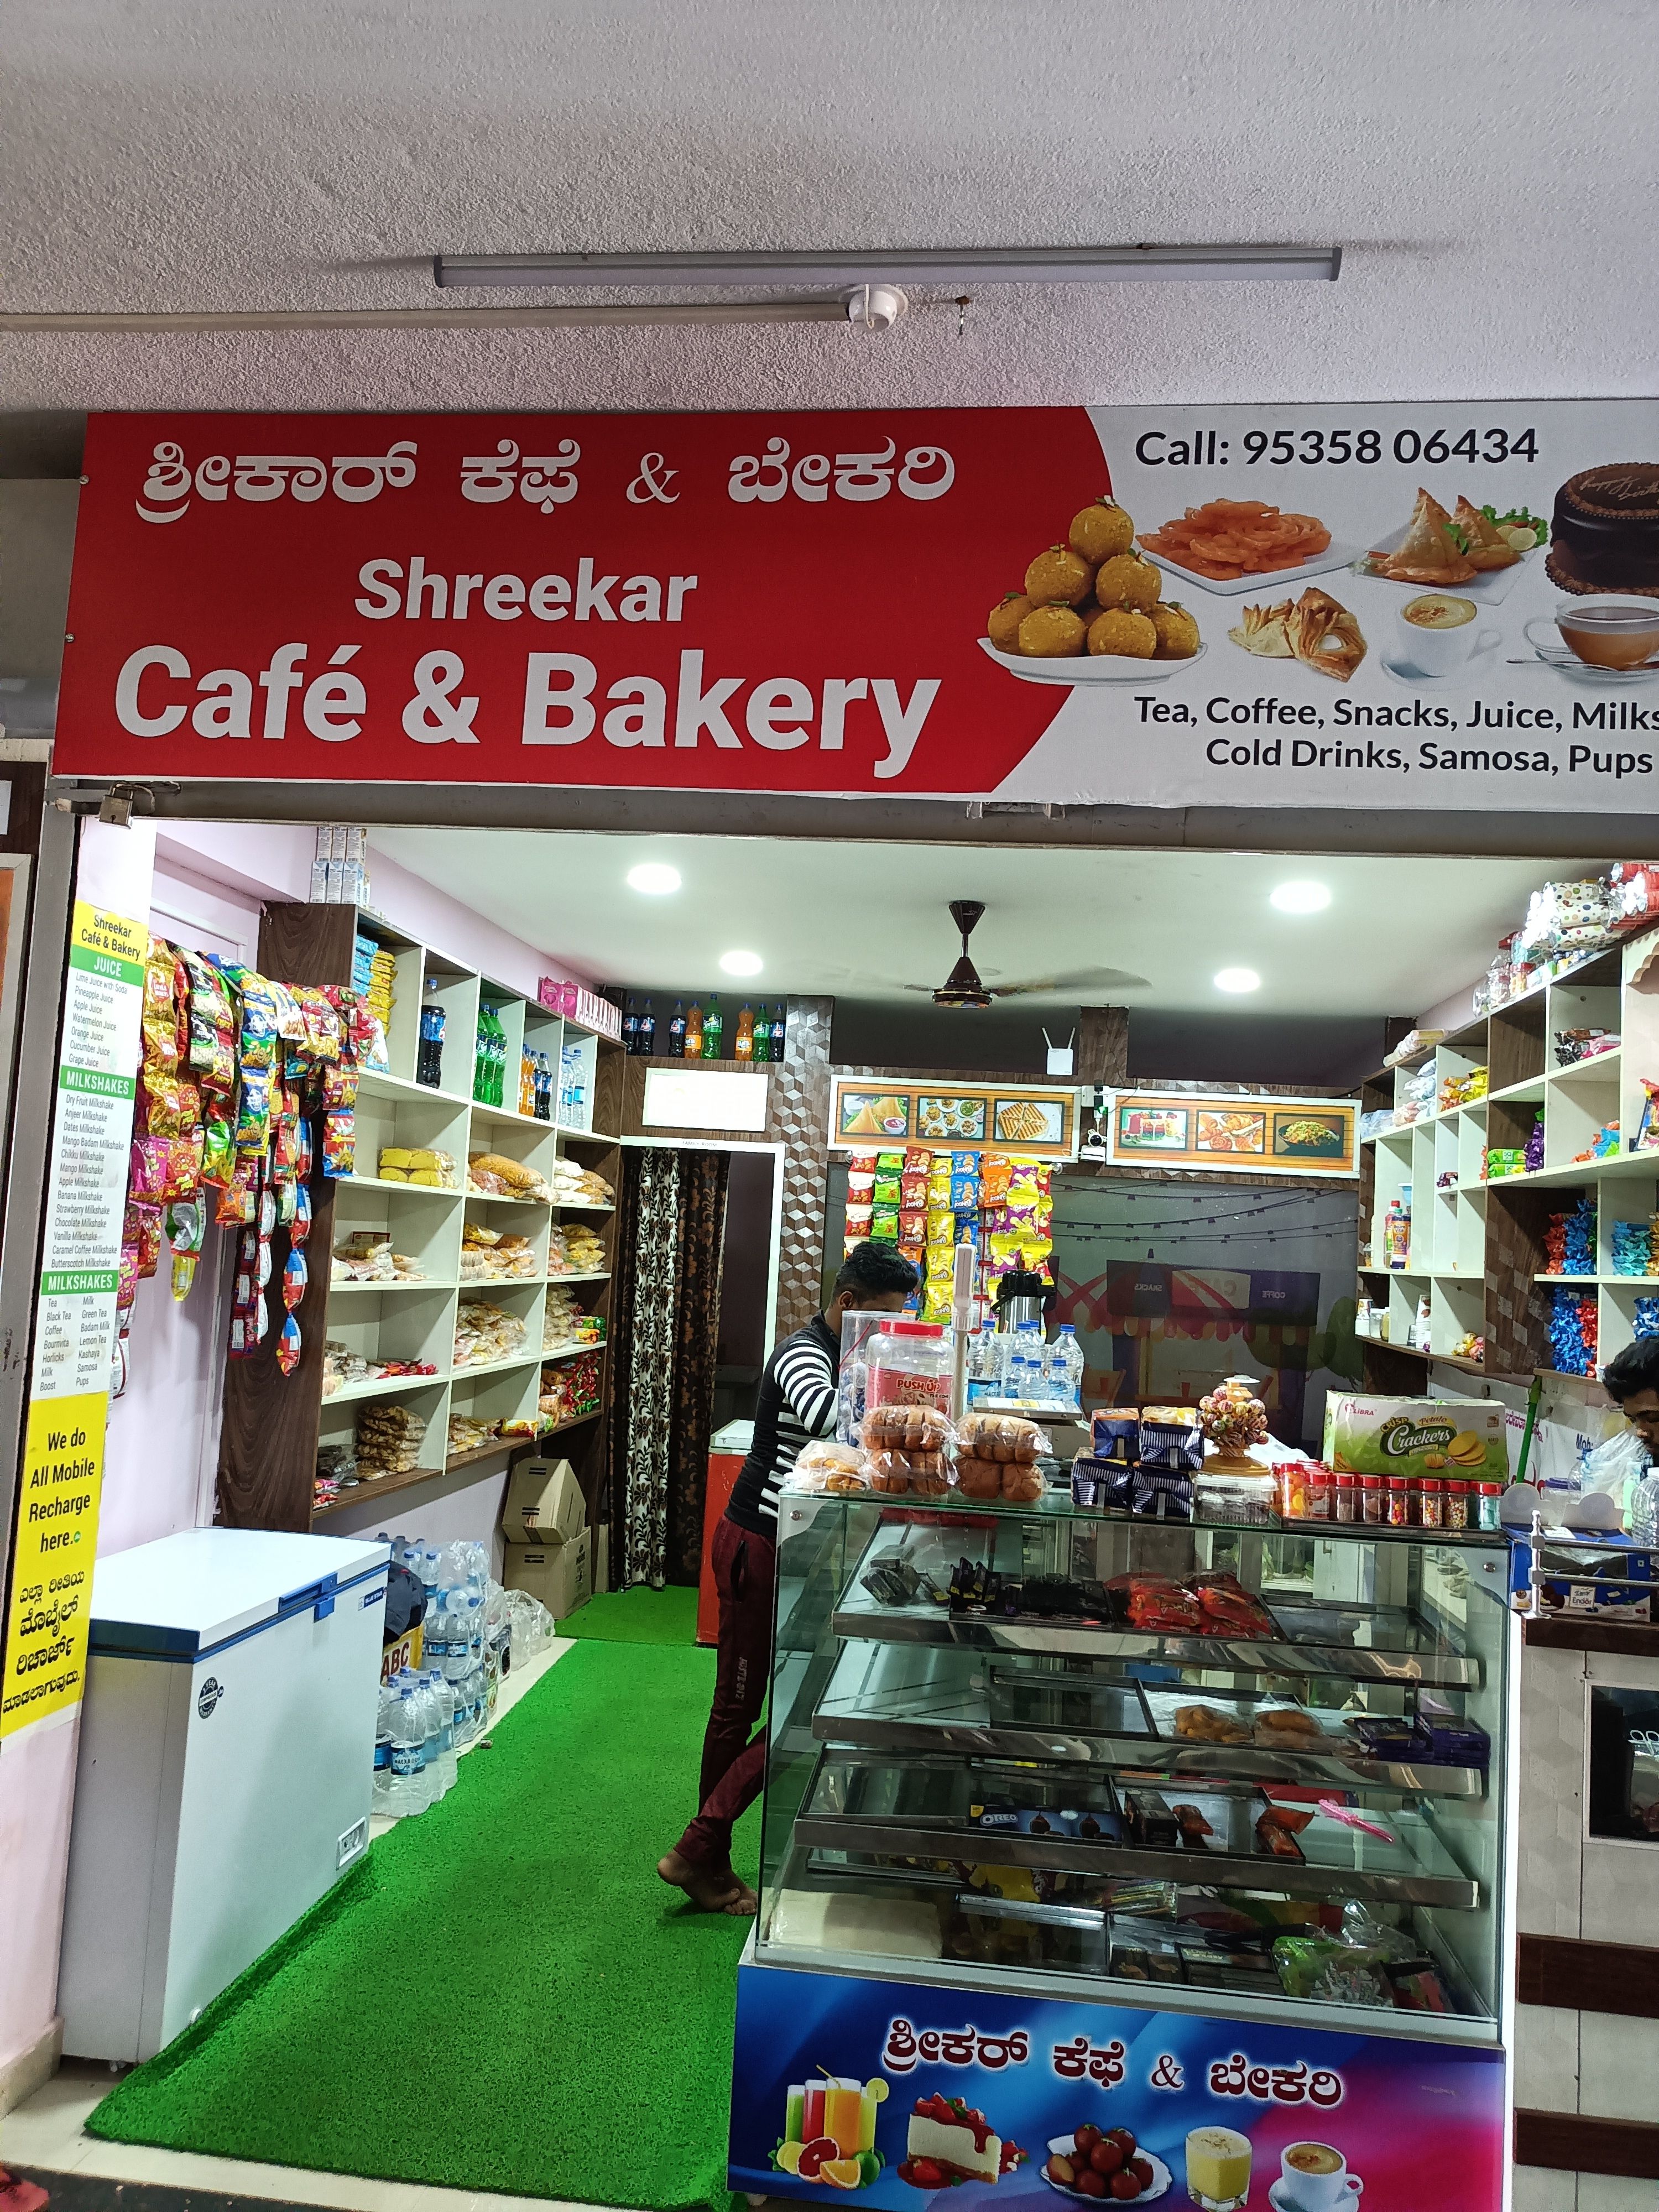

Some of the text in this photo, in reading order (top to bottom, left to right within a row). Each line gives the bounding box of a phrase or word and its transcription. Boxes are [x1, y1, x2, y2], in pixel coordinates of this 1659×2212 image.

[1136, 429, 1538, 465] Call: 95358 06434
[136, 436, 954, 523] ಶ್ರೀಕಾರ್ ಕೆಫೆ & ಬೇಕರಿ
[355, 557, 697, 622] Shreekar
[116, 643, 942, 778] Café & Bakery
[1134, 697, 1197, 727] Tea,
[1207, 697, 1324, 729] Coffee,
[1333, 699, 1457, 731] Snacks,
[1467, 701, 1562, 733] Juice,
[1207, 739, 1652, 779] Cold Drinks, Samosa, Pups
[94, 915, 132, 938] Shreekar
[82, 928, 140, 961] Café & Bakery
[94, 957, 122, 977] JUICE
[76, 972, 127, 994] Lime Juice with Soda
[75, 985, 113, 1004] Pineapple Juice
[74, 999, 102, 1014] Apple Juice
[73, 1013, 117, 1031] Watermelon Juice
[71, 1026, 104, 1041] Orange Juice
[70, 1040, 110, 1056] Cucumber Juice
[69, 1053, 99, 1068] Grape Juice
[66, 1070, 129, 1095] MILKSHAKES
[66, 1094, 114, 1110] Dry Fruit Milkshake
[65, 1108, 107, 1122] Anjeer Milkshake
[64, 1121, 105, 1135] Dates Milkshake
[62, 1135, 124, 1150] Mango Badam Milkshake
[80, 1151, 105, 1161] Milkshake
[60, 1163, 103, 1175] Mango Milkshake
[59, 1177, 100, 1188] Apple Milkshake
[58, 1191, 102, 1201] Banana Milkshake
[56, 1204, 110, 1216] Strawberry Milkshake
[55, 1218, 107, 1228] Chocolate Milkshake
[54, 1231, 97, 1240] Vanilla Milkshake
[53, 1245, 117, 1254] Caramel Coffee Milkshake
[51, 1259, 111, 1268] Butterscotch Milkshake
[48, 1274, 113, 1291] MILKSHAKES
[49, 1298, 57, 1307] Tea
[83, 1296, 94, 1305] Milk
[46, 1312, 71, 1322] Black Tea
[82, 1310, 97, 1319] Green
[45, 1326, 62, 1335] Coffee
[81, 1322, 110, 1332] Badam Milk
[44, 1339, 69, 1349] Bournvita
[80, 1335, 107, 1345] Lemon Tea
[43, 1354, 64, 1363] Horlicks
[79, 1350, 100, 1359] Kashaya
[41, 1368, 53, 1378] Milk
[77, 1363, 97, 1373] Samosa
[40, 1382, 56, 1391] Boost
[76, 1378, 89, 1387] Pups
[896, 1379, 925, 1391] PUSH
[48, 1427, 86, 1452] We do
[1387, 1425, 1451, 1454] Crackers
[30, 1458, 95, 1488] All Mobile
[29, 1493, 91, 1523] Recharge
[40, 1530, 74, 1553] here.
[20, 1571, 85, 1605] ಎಲ್ಲಾ ರೀತಿಯ
[382, 1641, 410, 1678] ABC
[982, 1814, 1018, 1824] OREO
[884, 2019, 1343, 2106] ಶ್ರೀಕರ್ ಕೆಫೆ & ಬೇಕರಿ
